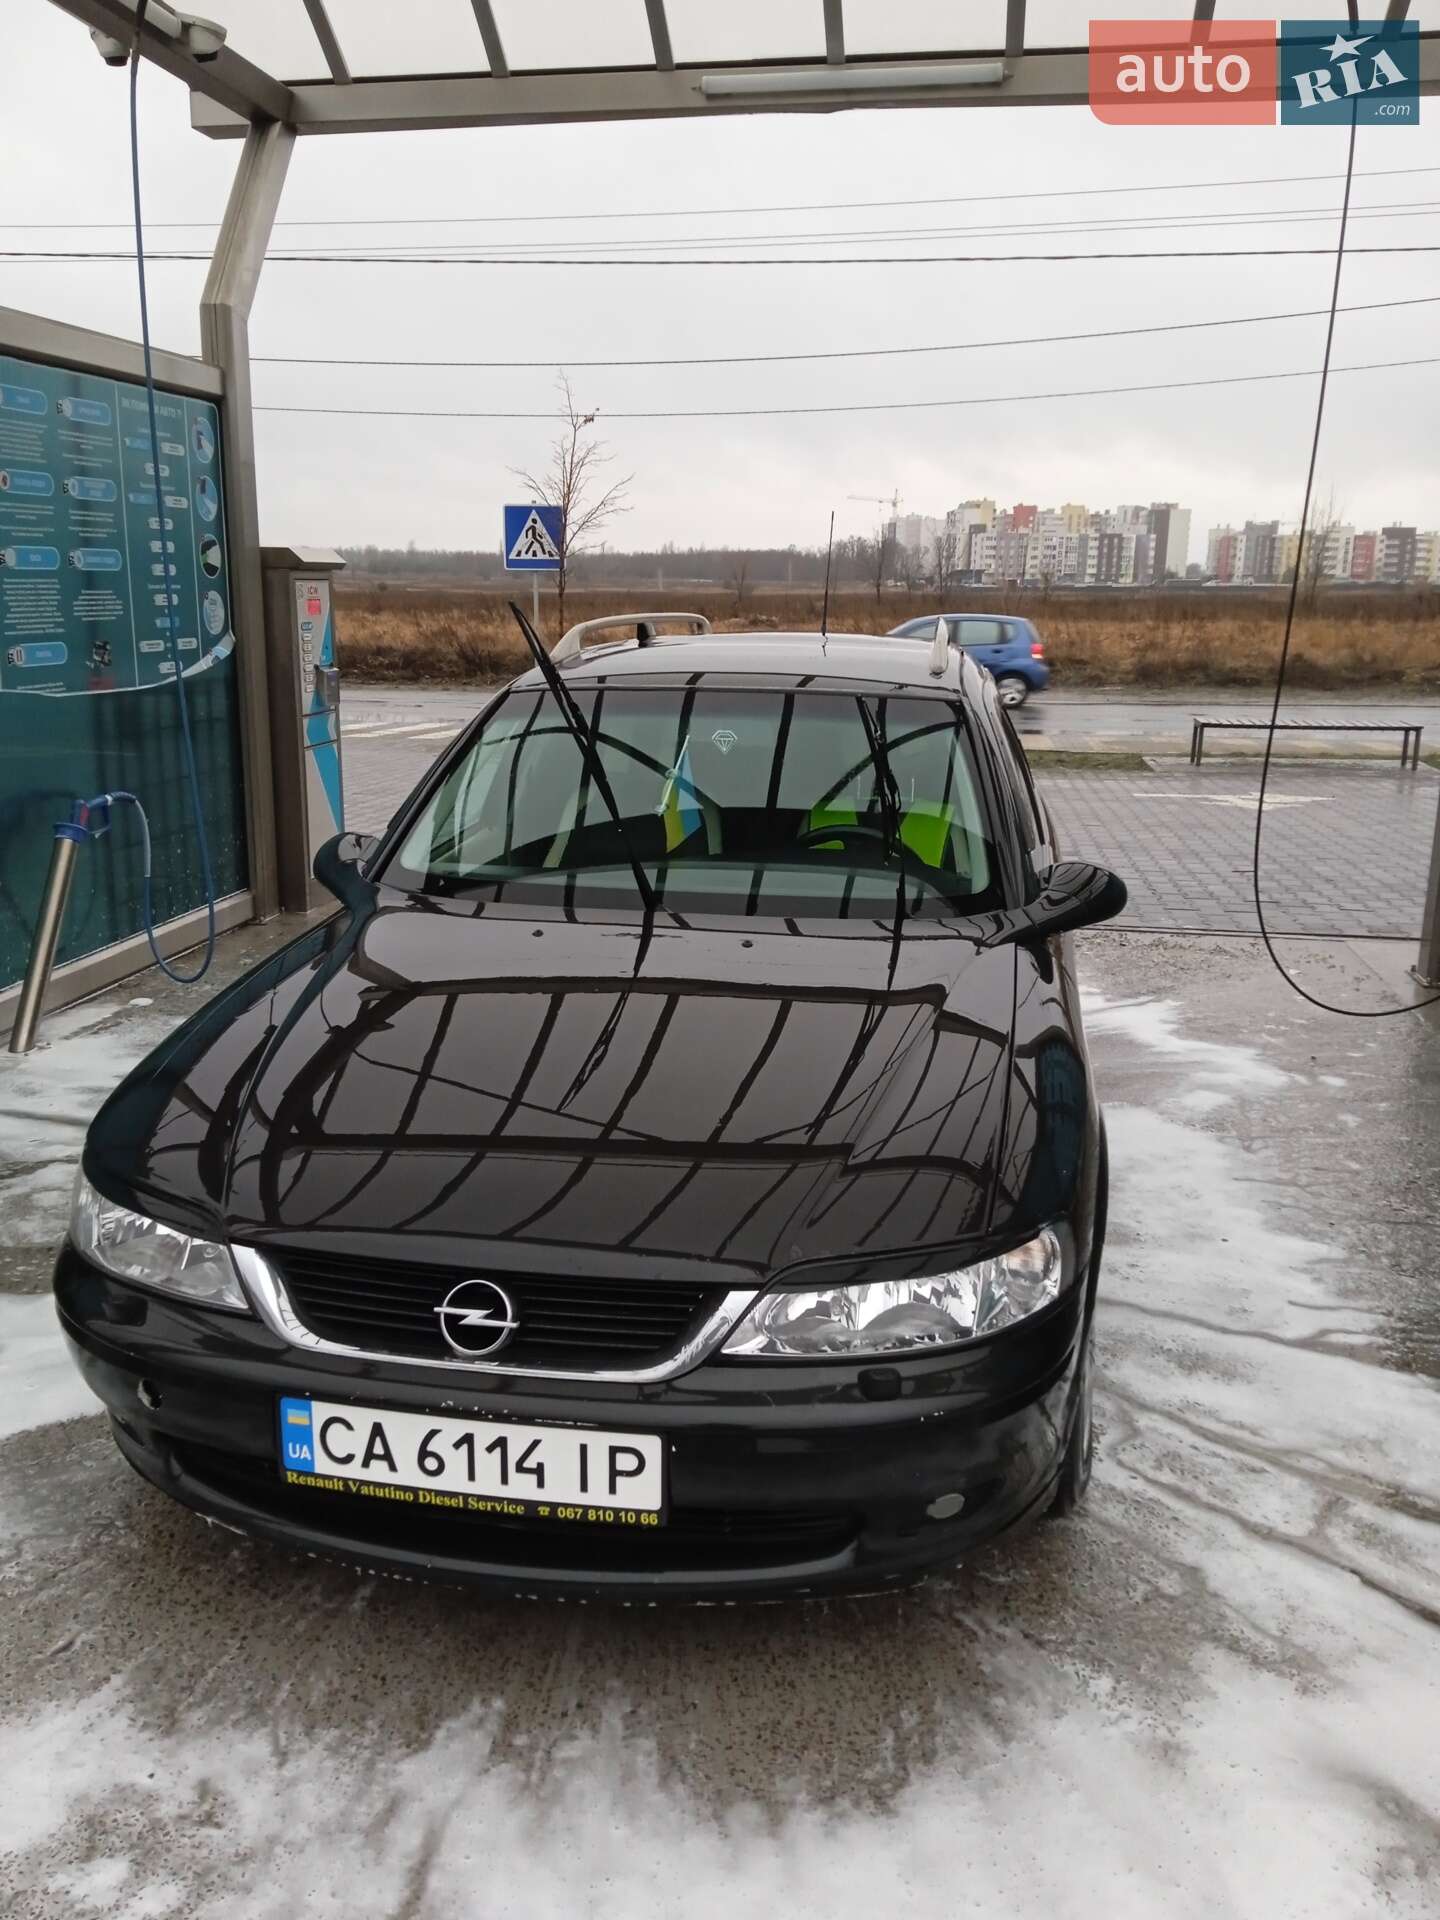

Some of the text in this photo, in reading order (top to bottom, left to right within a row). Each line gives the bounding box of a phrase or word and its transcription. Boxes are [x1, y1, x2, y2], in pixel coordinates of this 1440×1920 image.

[288, 1442, 312, 1461] UA
[319, 1416, 647, 1496] CA 6114 IP
[286, 1471, 659, 1526] Renault Vatutino Diesel Service 067 810 10 66
